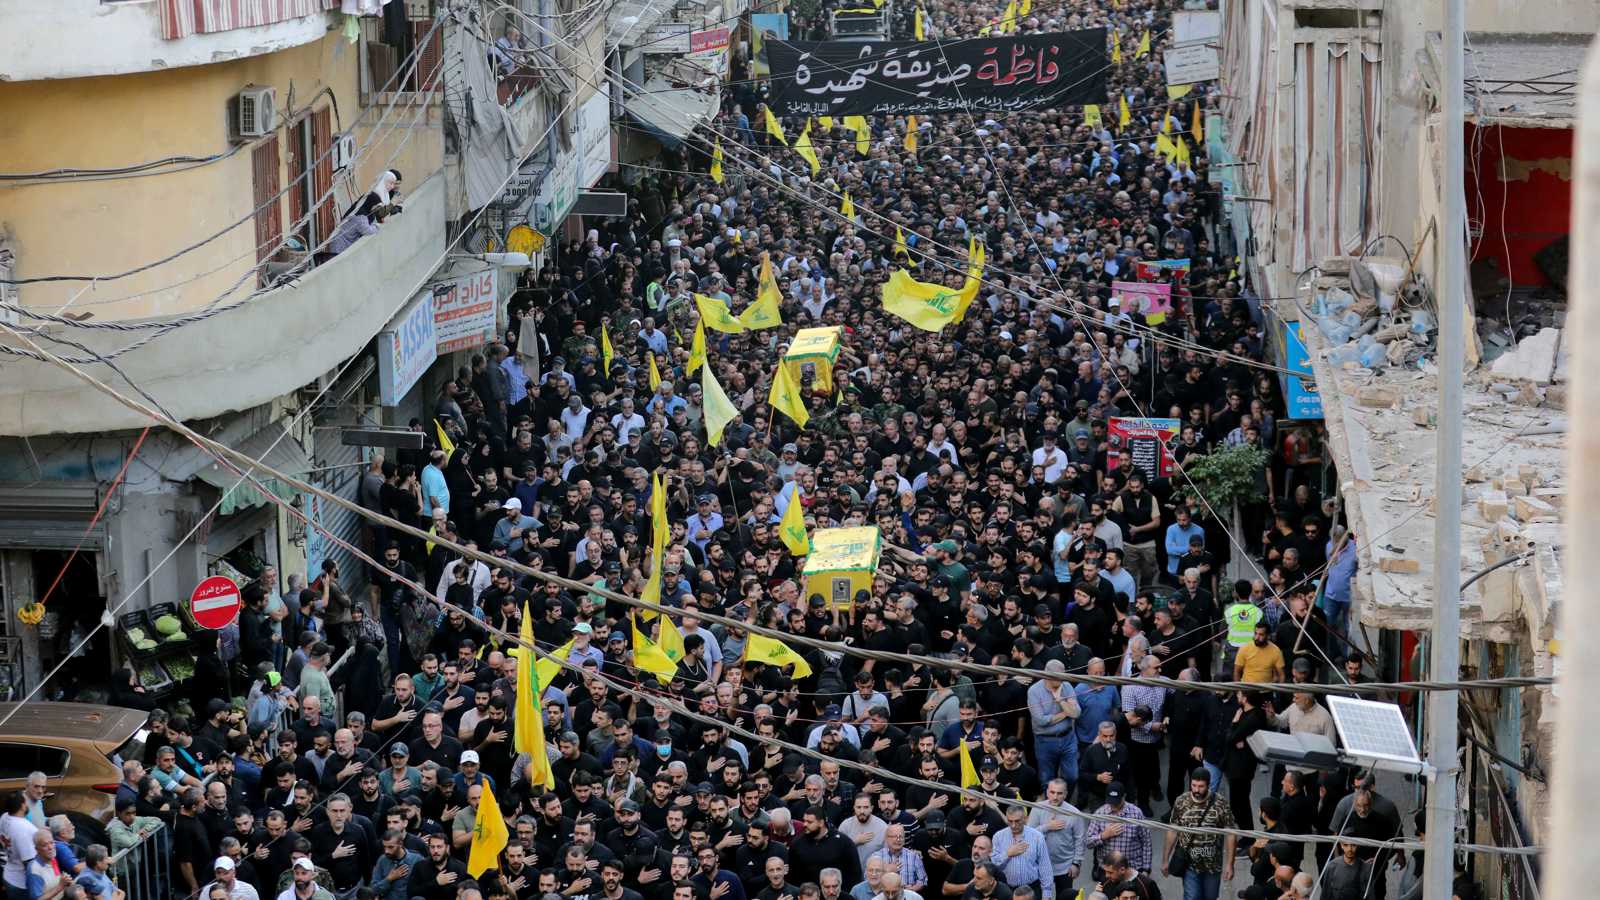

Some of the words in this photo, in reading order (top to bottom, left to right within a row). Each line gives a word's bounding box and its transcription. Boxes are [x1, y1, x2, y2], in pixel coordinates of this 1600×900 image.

[795, 44, 879, 104] شهيدة
[976, 44, 1060, 86] فاطمة
[461, 273, 493, 305] كاراج
[201, 586, 215, 596] المرور
[216, 584, 231, 594] ممنوع
